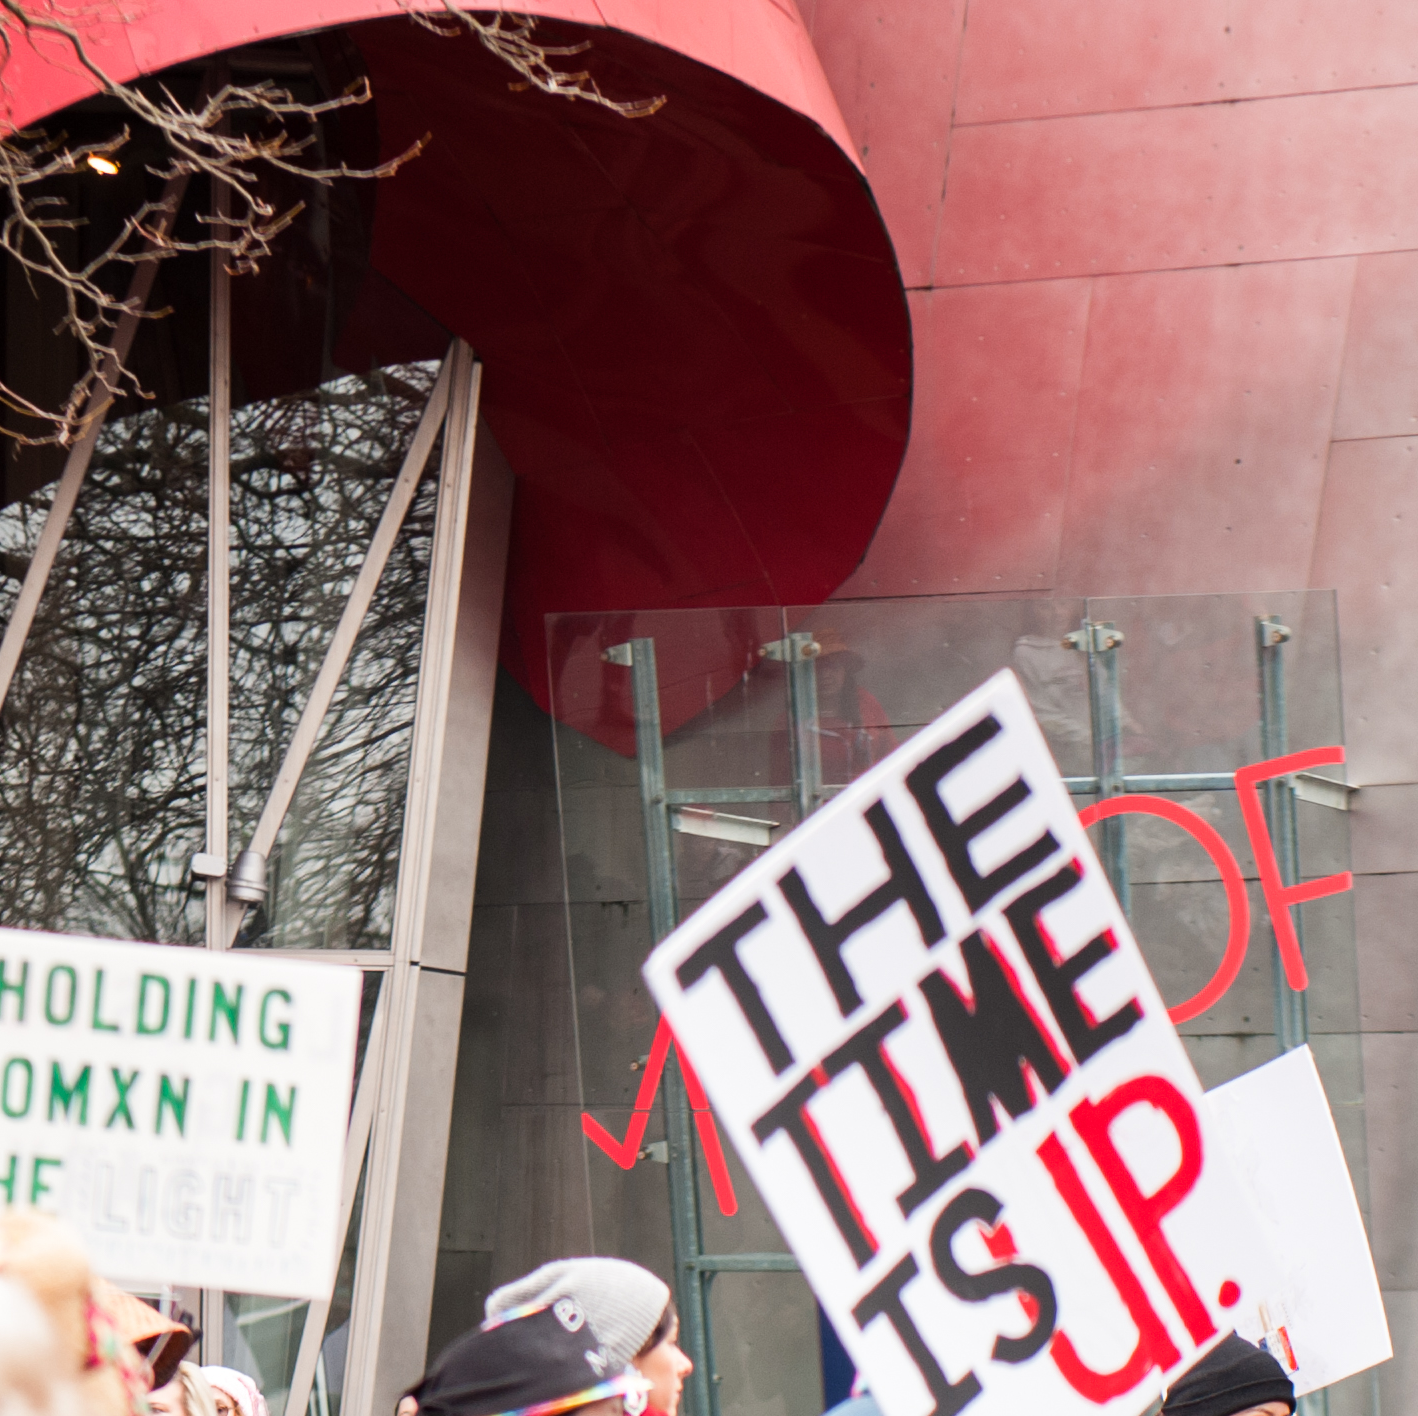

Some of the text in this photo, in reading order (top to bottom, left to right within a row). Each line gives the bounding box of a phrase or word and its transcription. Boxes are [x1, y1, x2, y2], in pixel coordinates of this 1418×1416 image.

[675, 713, 1062, 1078] THE
[93, 1160, 300, 1250] LIGHT
[236, 1078, 299, 1147] IN
[750, 856, 1145, 1272] TIME
[1036, 1074, 1242, 1405] UP.
